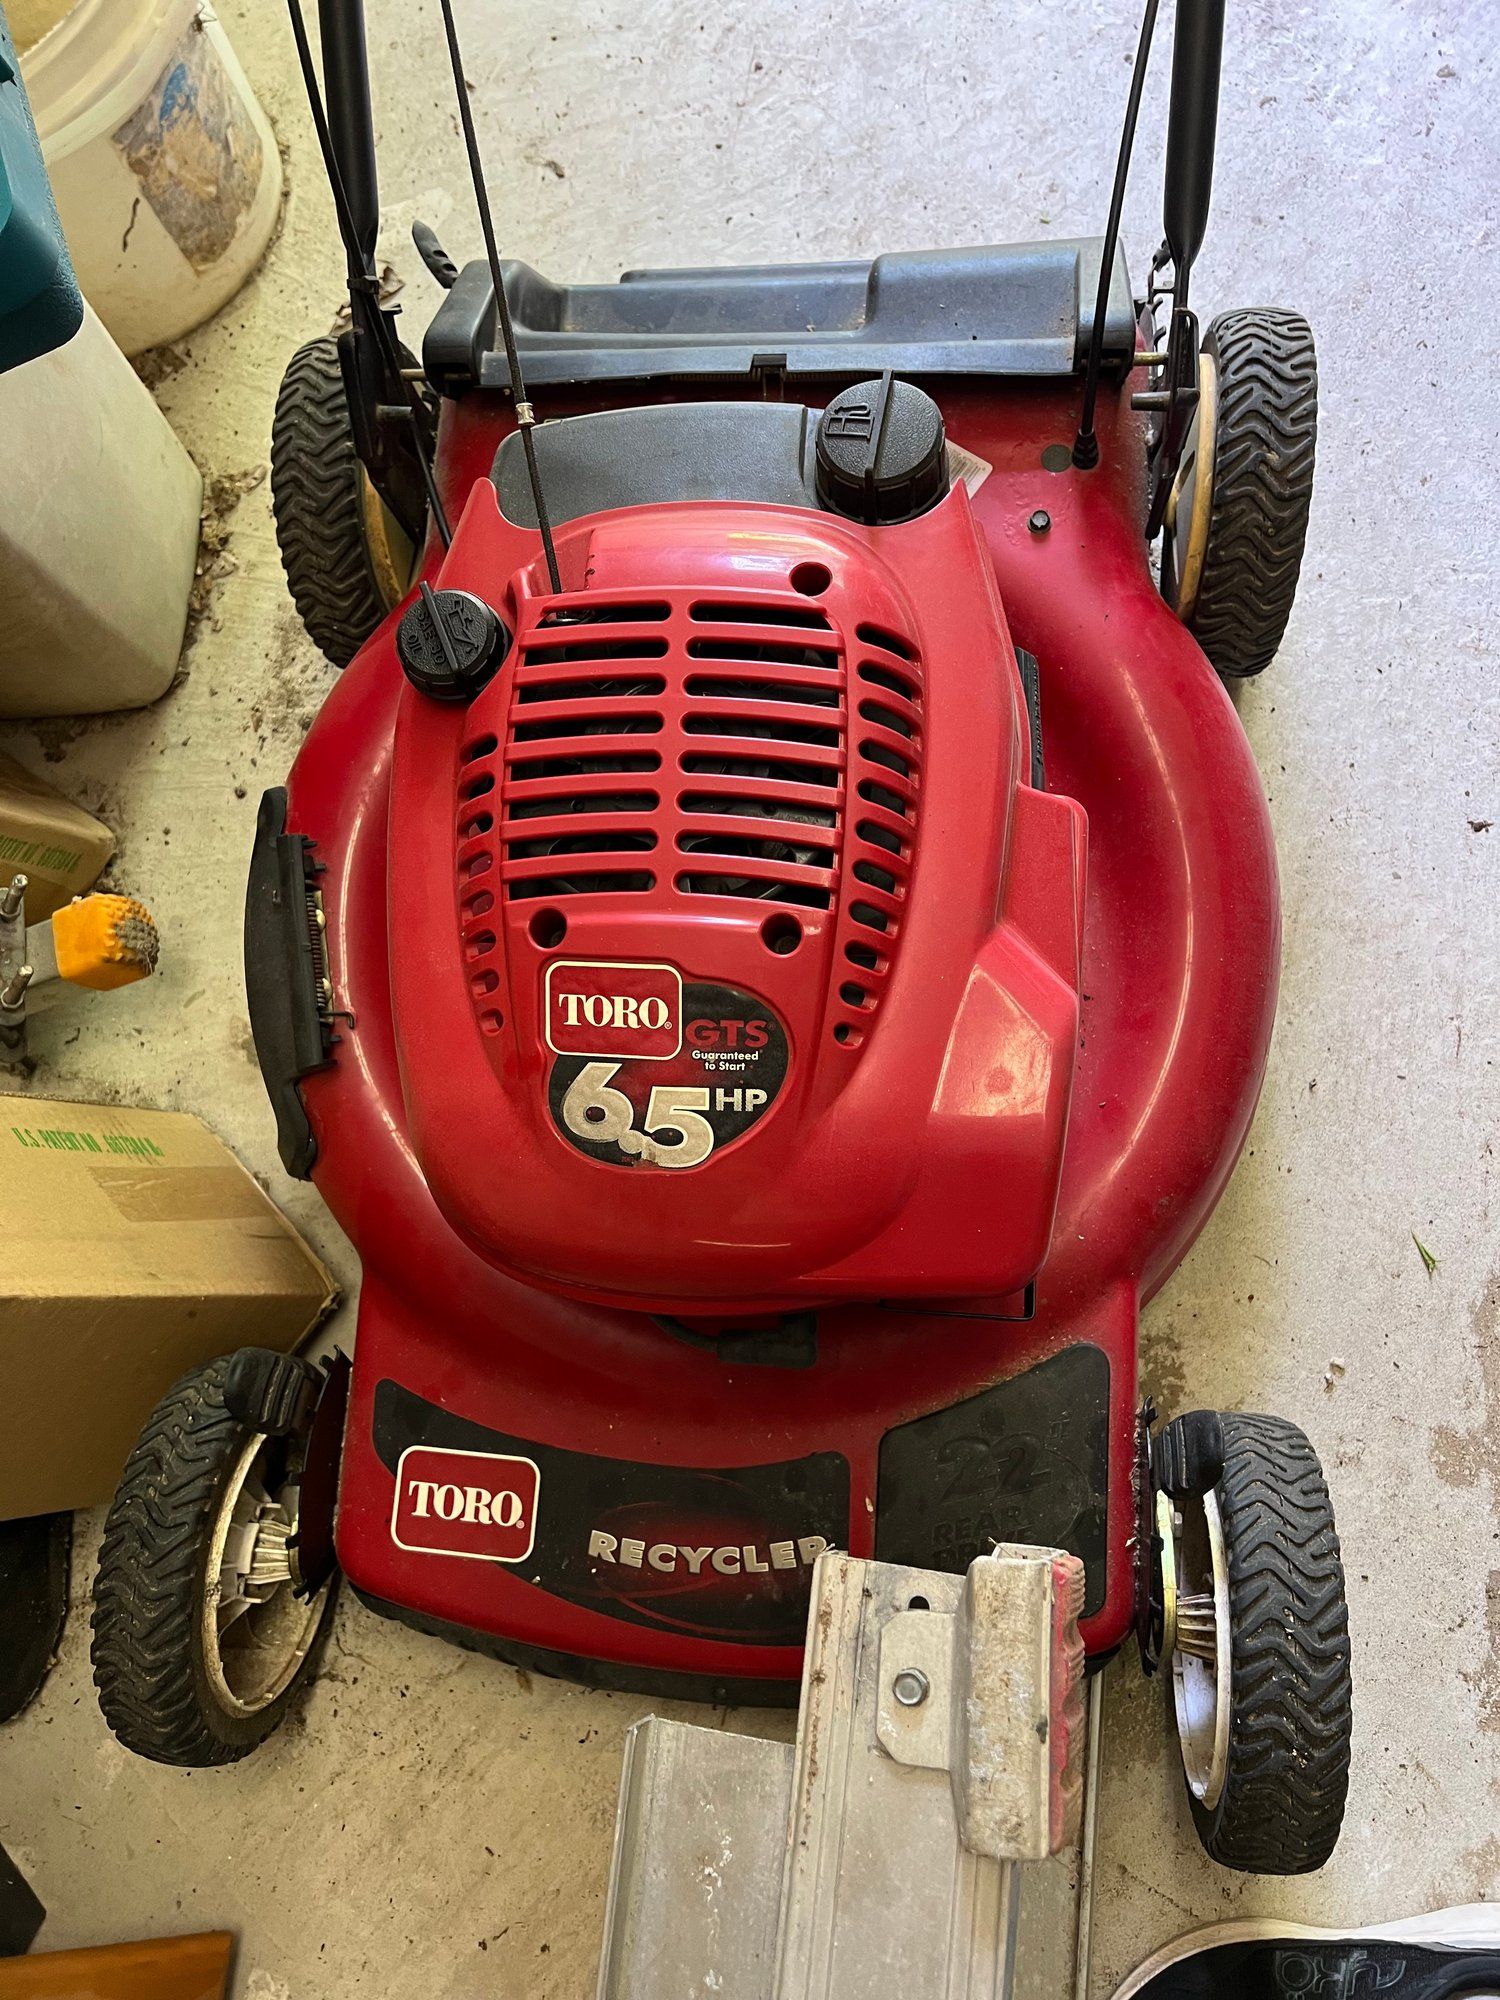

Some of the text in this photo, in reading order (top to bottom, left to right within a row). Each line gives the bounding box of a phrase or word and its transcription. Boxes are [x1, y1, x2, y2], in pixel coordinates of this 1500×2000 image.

[408, 634, 423, 654] OIL
[558, 993, 670, 1030] TORO
[684, 1018, 769, 1048] GTS
[691, 1049, 760, 1061] Guaranteed
[704, 1061, 746, 1071] to Start
[715, 1087, 768, 1112] HP
[11, 1127, 45, 1148] U.S.
[38, 1129, 85, 1151] PATENT
[408, 1480, 524, 1528] TORO
